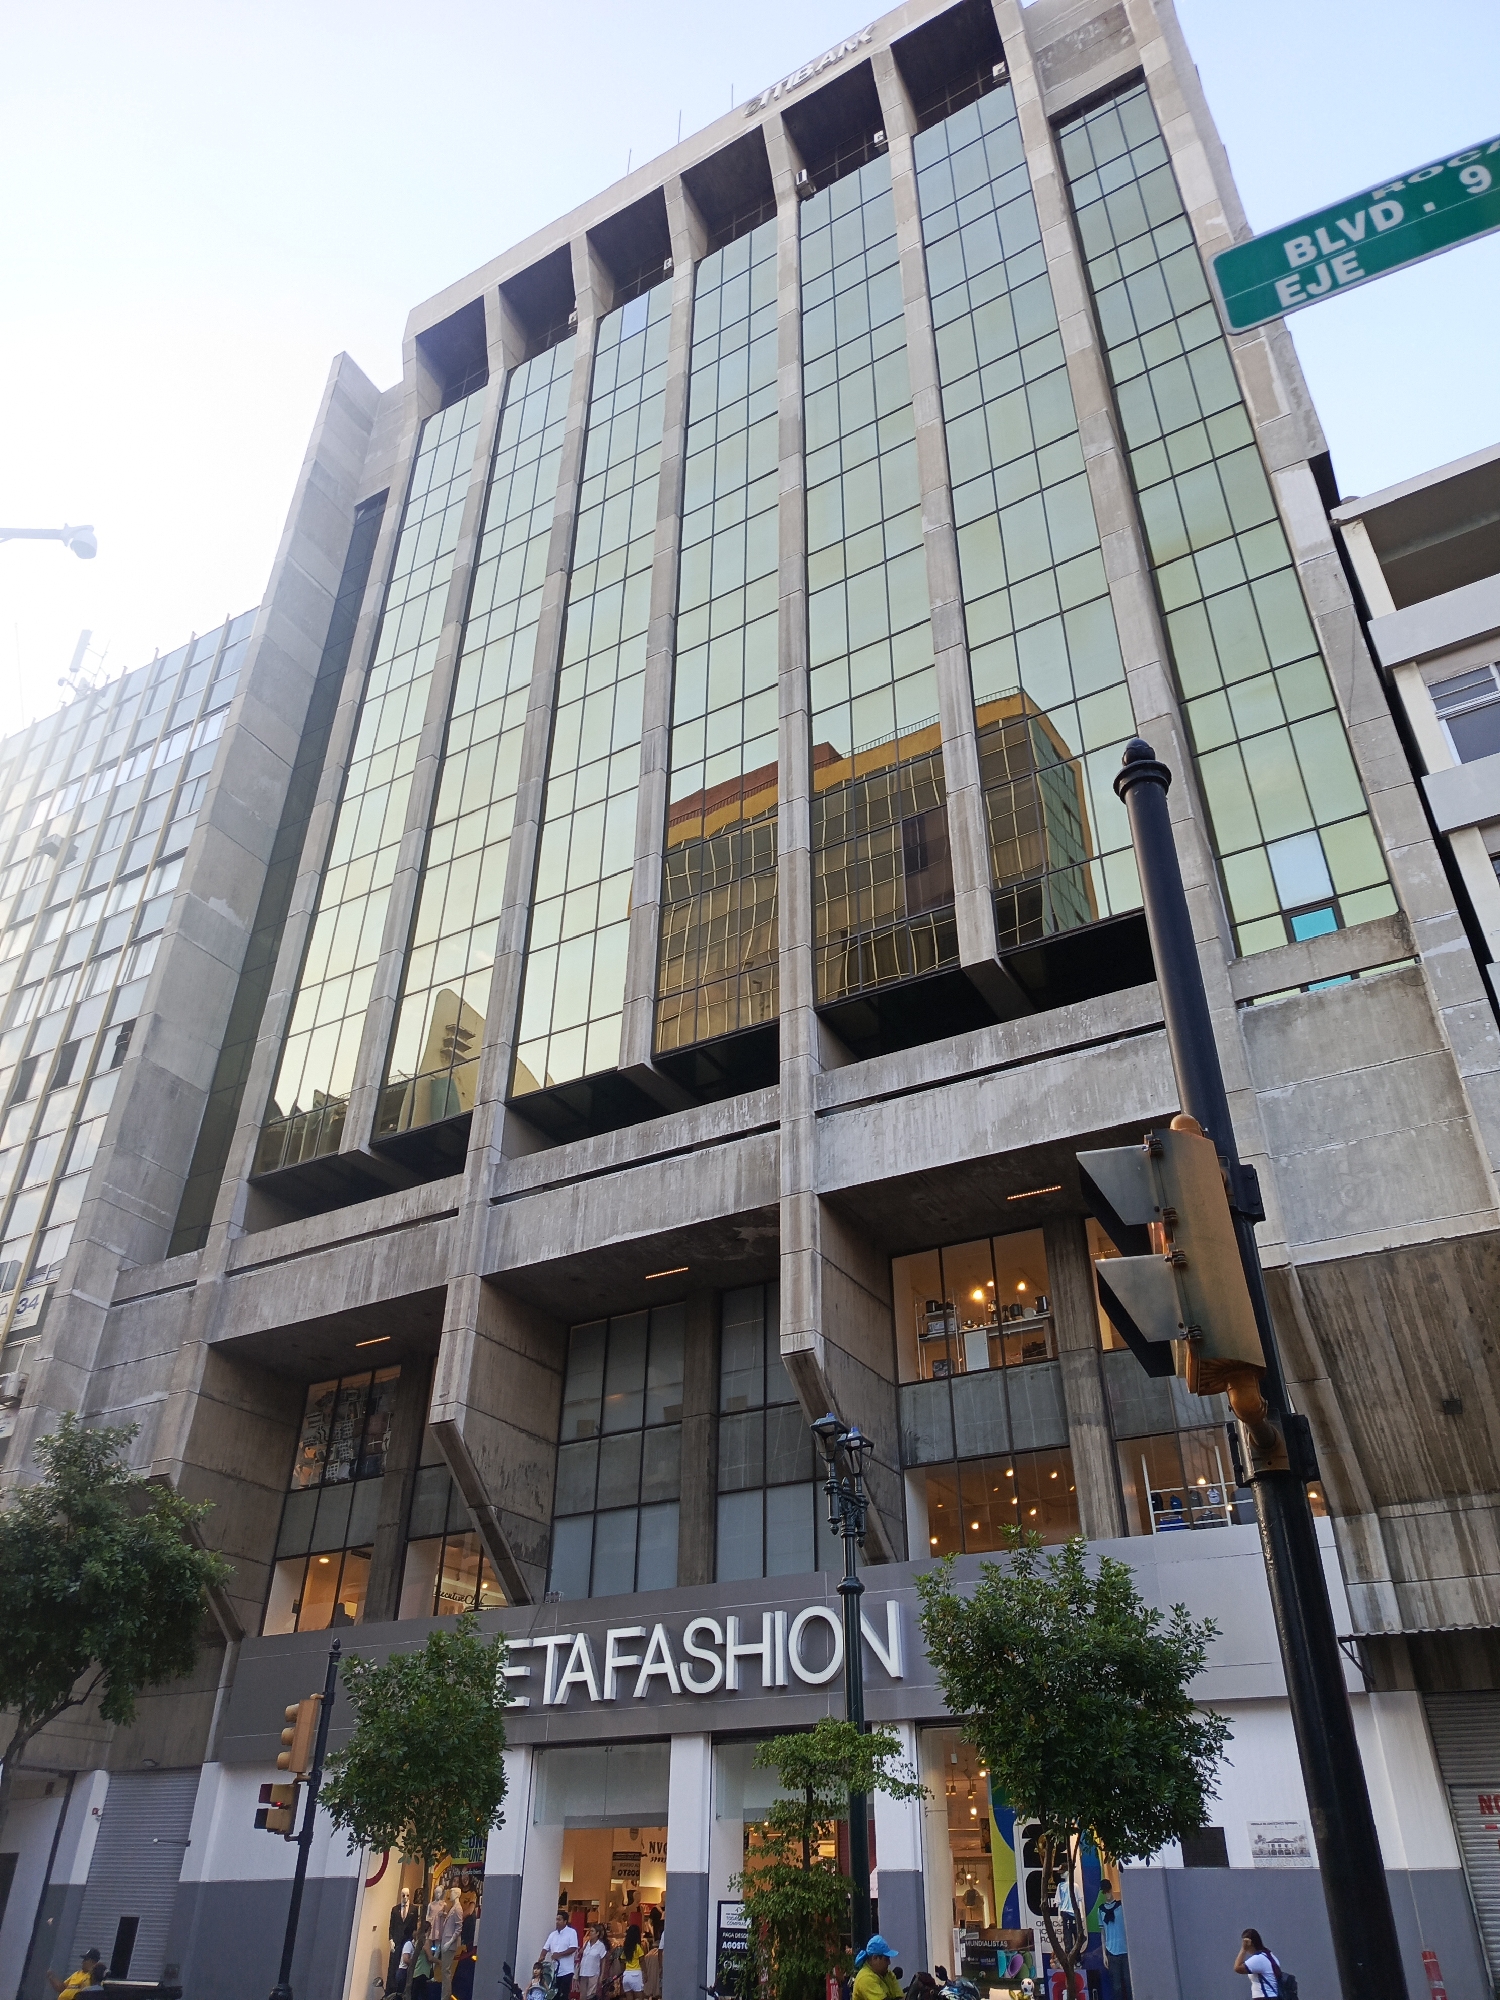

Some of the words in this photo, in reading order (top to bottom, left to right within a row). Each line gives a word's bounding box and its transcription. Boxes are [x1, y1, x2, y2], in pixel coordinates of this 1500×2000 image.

[744, 23, 876, 118] CITIBANK
[1459, 165, 1492, 194] 9
[1274, 251, 1365, 308] EJE
[493, 1600, 903, 1707] ETAFASHION
